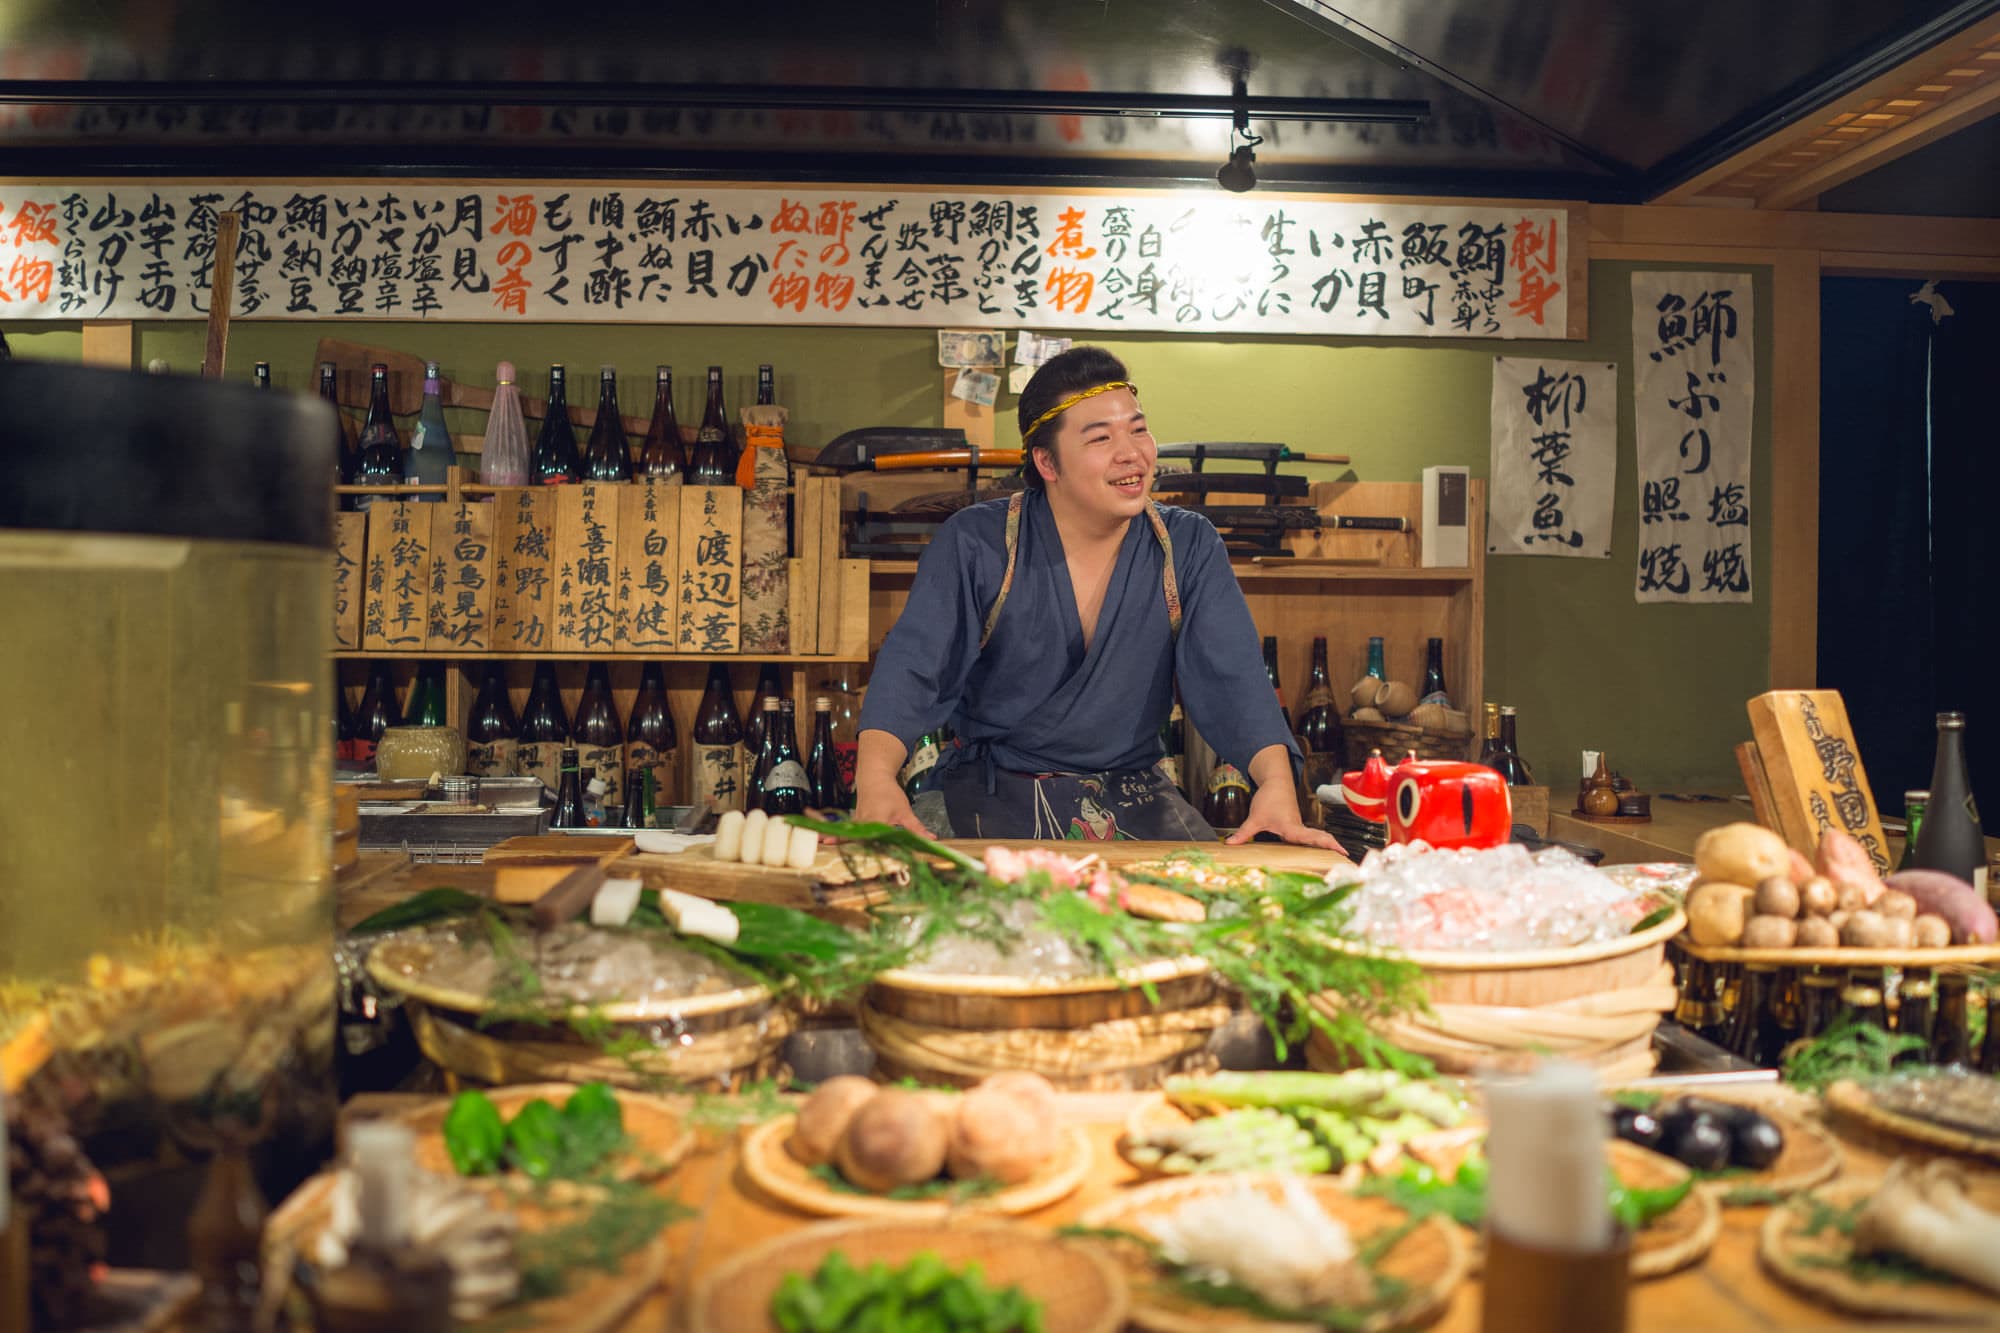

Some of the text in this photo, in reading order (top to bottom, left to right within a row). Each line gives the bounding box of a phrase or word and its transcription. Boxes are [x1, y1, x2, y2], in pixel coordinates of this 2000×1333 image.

[9, 200, 60, 304] 飯物
[57, 193, 89, 313] おくら刻み
[89, 192, 135, 317] 山かけ
[278, 194, 327, 312] 鮪納豆
[327, 196, 371, 314] いか納豆
[404, 199, 447, 318] いか塩辛
[448, 194, 490, 294] 月見
[490, 194, 538, 315] 酒の肴
[539, 193, 584, 305] もずく
[629, 197, 680, 303] 鮪ぬた
[681, 200, 720, 298] 赤貝
[726, 213, 770, 296] いか
[767, 198, 813, 313] ぬた物
[813, 200, 858, 313] 酢の物
[858, 200, 900, 309] ぜんまい
[926, 200, 968, 305] 野菜
[1011, 206, 1041, 319] きんき
[1045, 206, 1097, 314] 煮物
[1095, 204, 1135, 321] 盛り合せ
[1128, 223, 1168, 315] 白身
[1257, 208, 1296, 317] 生うに
[1309, 229, 1354, 313] いか
[1352, 217, 1393, 320] 赤貝
[1449, 221, 1507, 286] 鮪
[1508, 216, 1561, 326] 刺身
[1451, 282, 1480, 332] 赤身
[1522, 366, 1586, 548] 柳葉魚
[1638, 477, 1691, 595] 照焼
[1701, 481, 1750, 594] 塩焼
